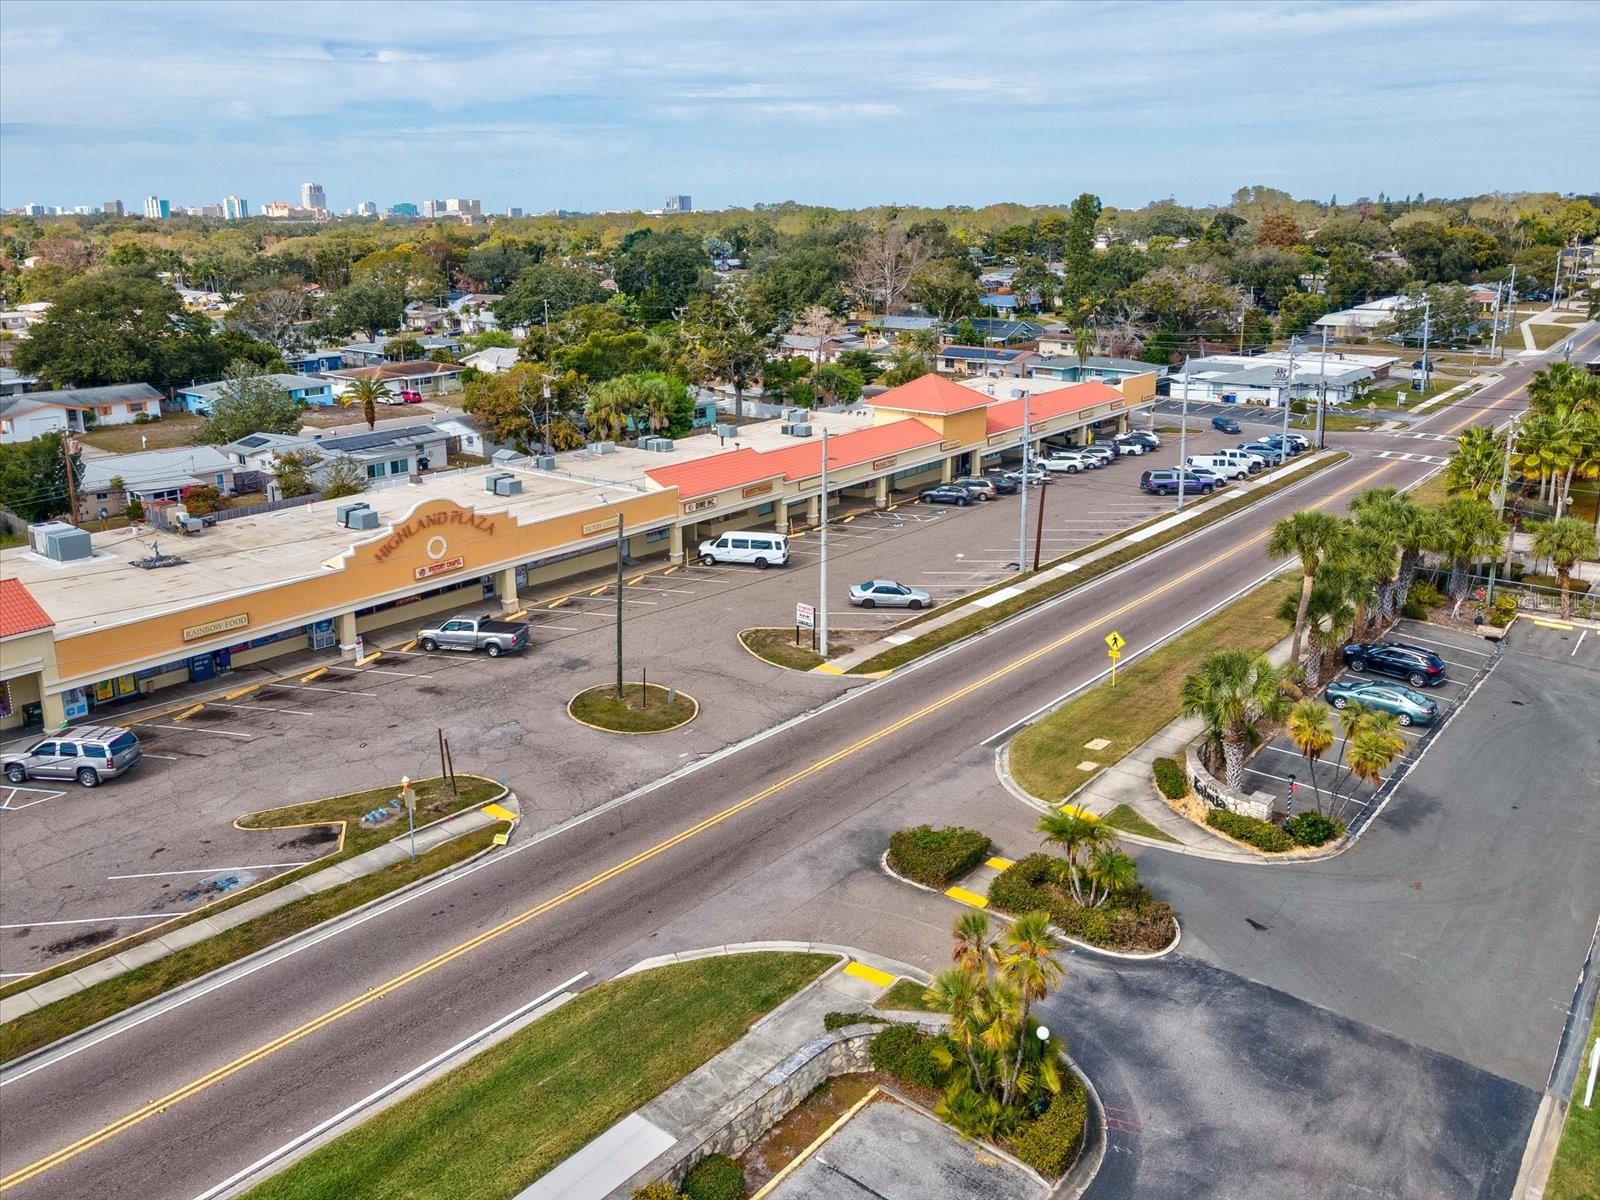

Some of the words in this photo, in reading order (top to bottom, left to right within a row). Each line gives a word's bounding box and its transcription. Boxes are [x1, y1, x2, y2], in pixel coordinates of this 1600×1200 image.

[374, 511, 449, 561] HIGHLAND
[450, 510, 496, 536] PLAZA
[428, 562, 446, 573] VICTORY
[446, 558, 462, 569] CHAPEL
[185, 622, 224, 638] RAINBOW
[224, 616, 247, 629] FOOD
